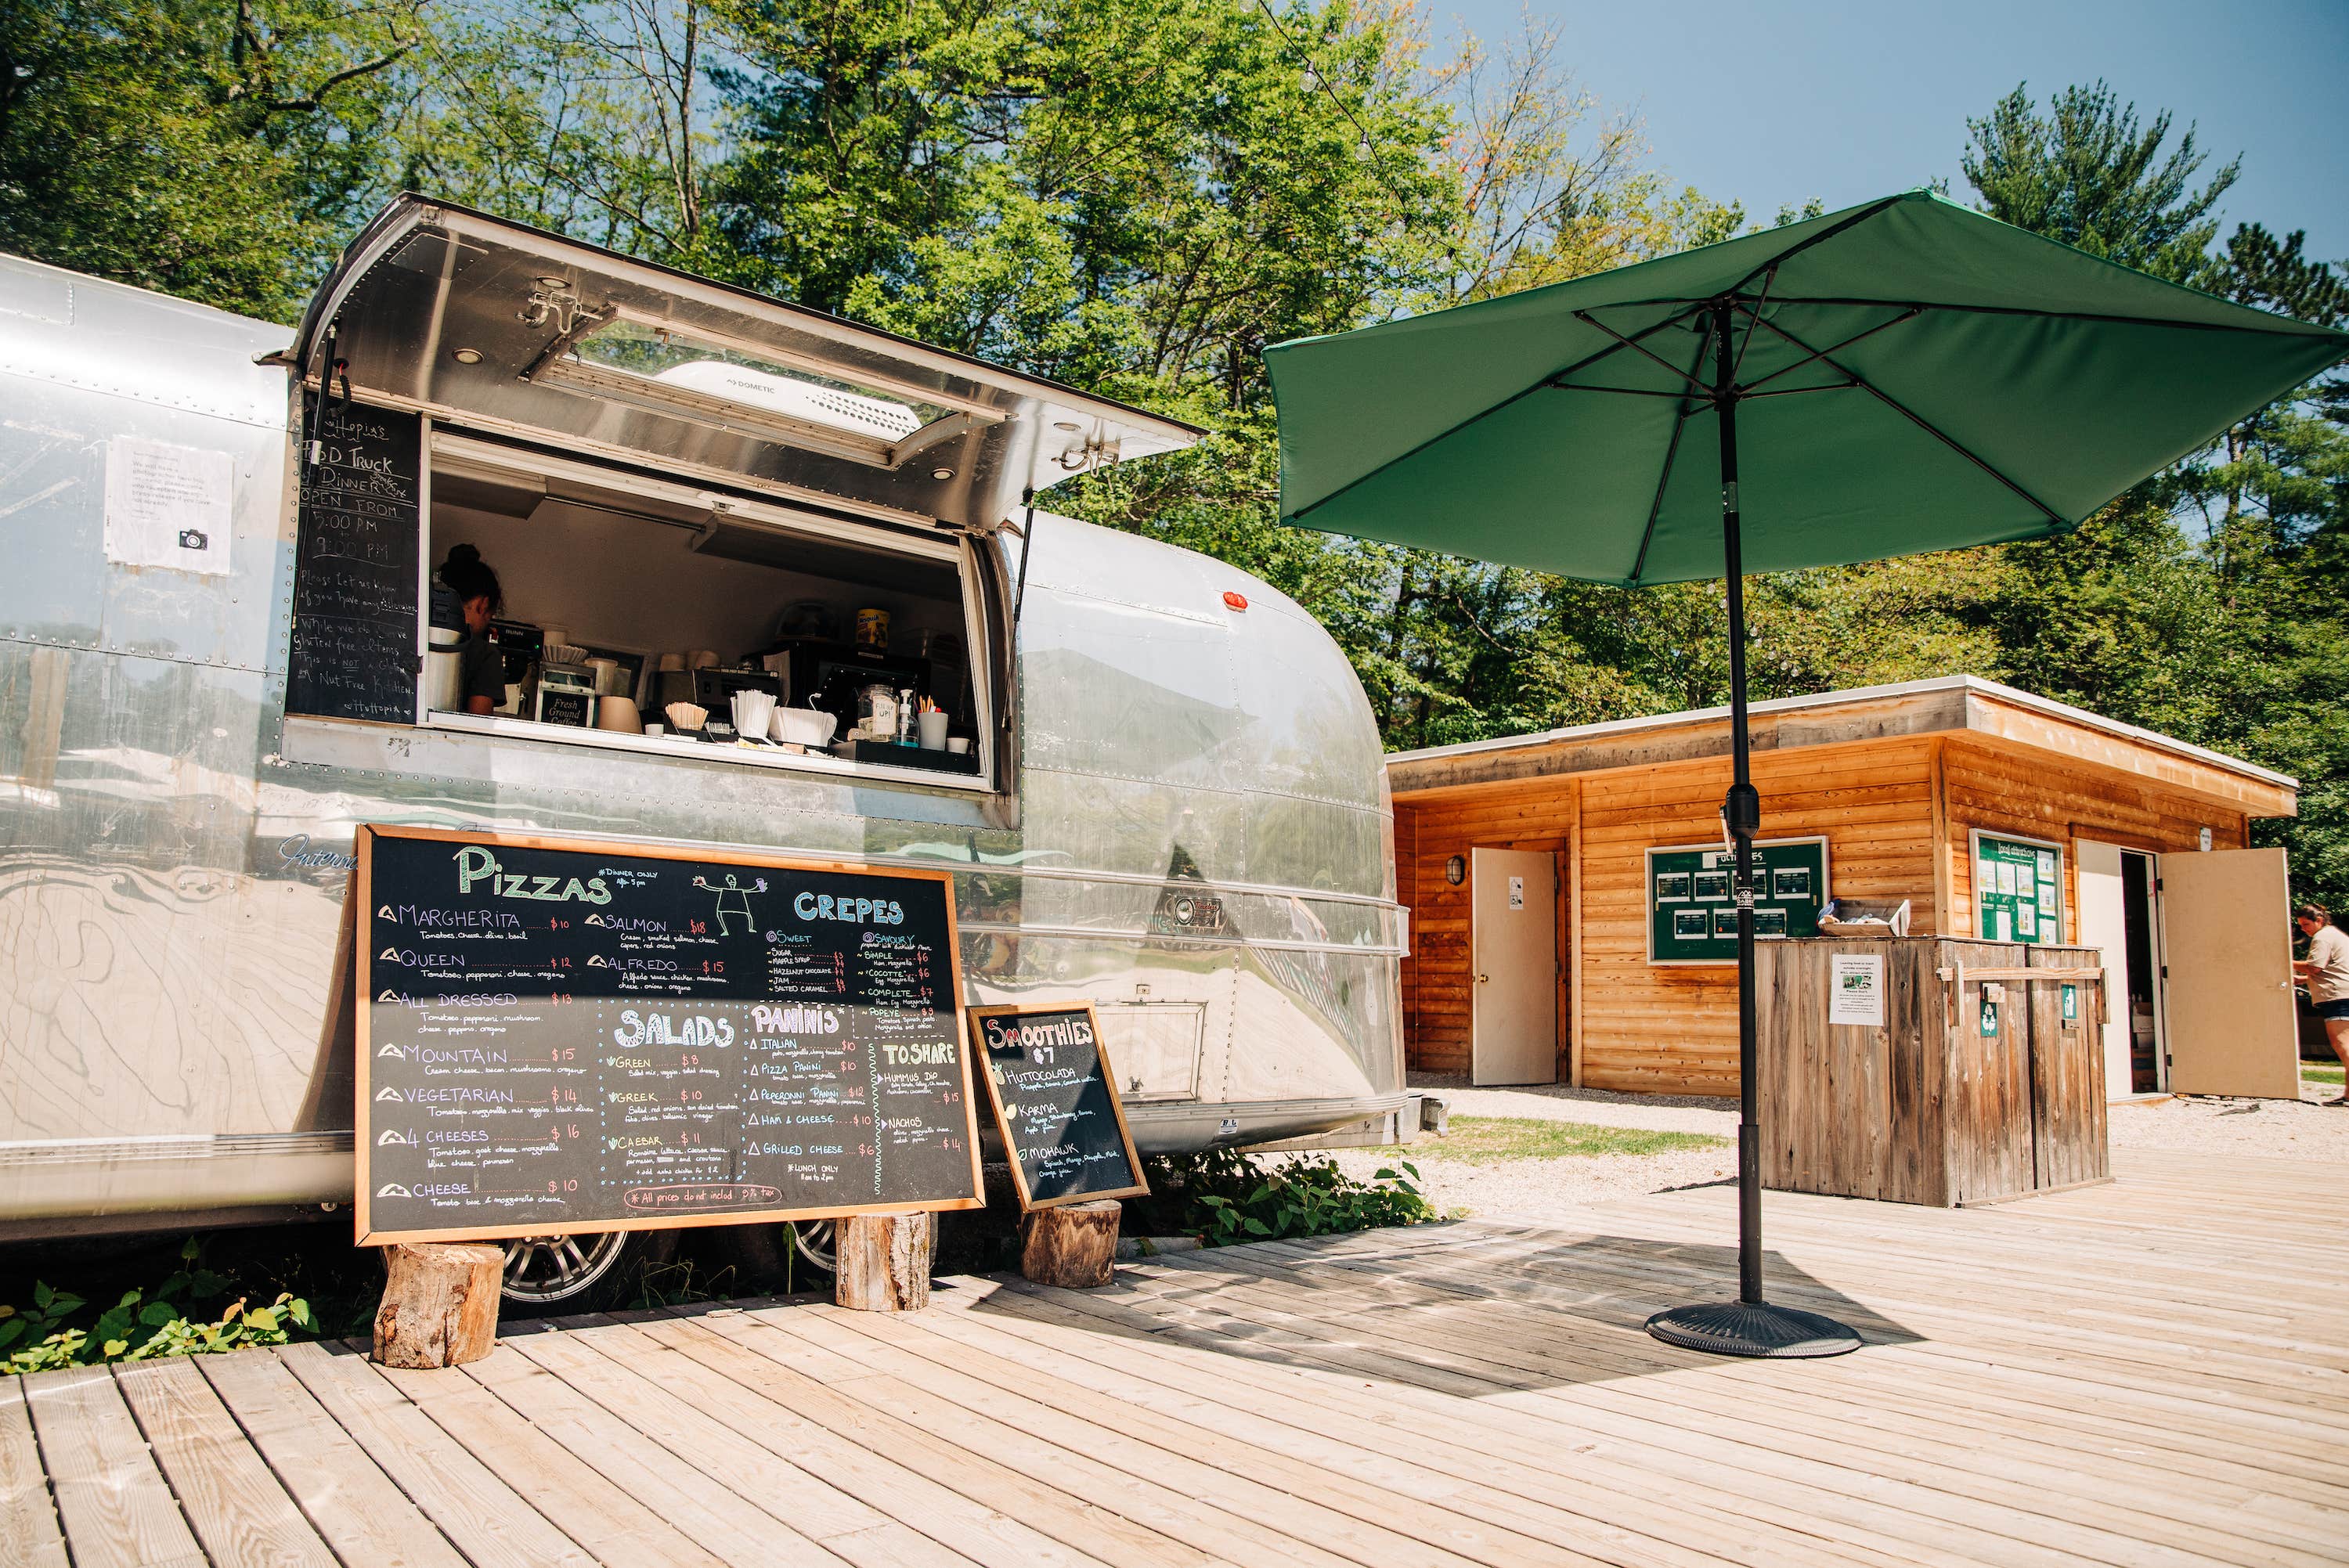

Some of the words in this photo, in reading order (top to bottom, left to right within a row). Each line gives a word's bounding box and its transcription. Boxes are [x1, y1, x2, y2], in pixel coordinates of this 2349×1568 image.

[738, 380, 775, 394] DOMETIC
[301, 488, 341, 507] OPEN
[355, 499, 398, 517] FROM
[342, 659, 360, 668] NOT
[554, 697, 578, 709] Fresh
[549, 707, 580, 719] Ground
[550, 716, 577, 726] Coffee
[793, 892, 904, 925] CREPES
[605, 914, 666, 932] SALMON
[690, 918, 706, 935] $18
[776, 929, 812, 943] SWEET
[874, 933, 915, 946] SAVOURY
[399, 950, 465, 967] QUEEN
[770, 947, 792, 957] SUGAR
[608, 957, 678, 971] ALFREDO
[868, 988, 913, 997] COMPLETE
[399, 992, 429, 1009] ALL
[438, 993, 518, 1007] DRESSED
[868, 1007, 901, 1018] POPEYE
[613, 1009, 734, 1048] SALADS
[841, 1040, 856, 1051] $10
[615, 1055, 651, 1069] GREEN
[1034, 1046, 1055, 1065] $7
[840, 1060, 857, 1073] $10
[883, 1072, 920, 1083] HUMMUS
[1005, 1067, 1076, 1085] HUTTOCOLADA
[617, 1091, 659, 1103] GREEK
[847, 1086, 864, 1098] $12
[1018, 1102, 1059, 1118] KARMA
[761, 1115, 782, 1126] HAM
[796, 1114, 835, 1124] CHEESE
[888, 1116, 922, 1129] NACHOS
[406, 1127, 420, 1148] 4
[426, 1130, 489, 1143] CHEESES
[617, 1136, 663, 1150] CAESAR
[810, 1145, 843, 1154] CHEESE
[1029, 1143, 1080, 1159] MOHAWK
[413, 1183, 471, 1197] CHEESE
[656, 1193, 680, 1206] prices
[760, 1187, 775, 1197] tax
